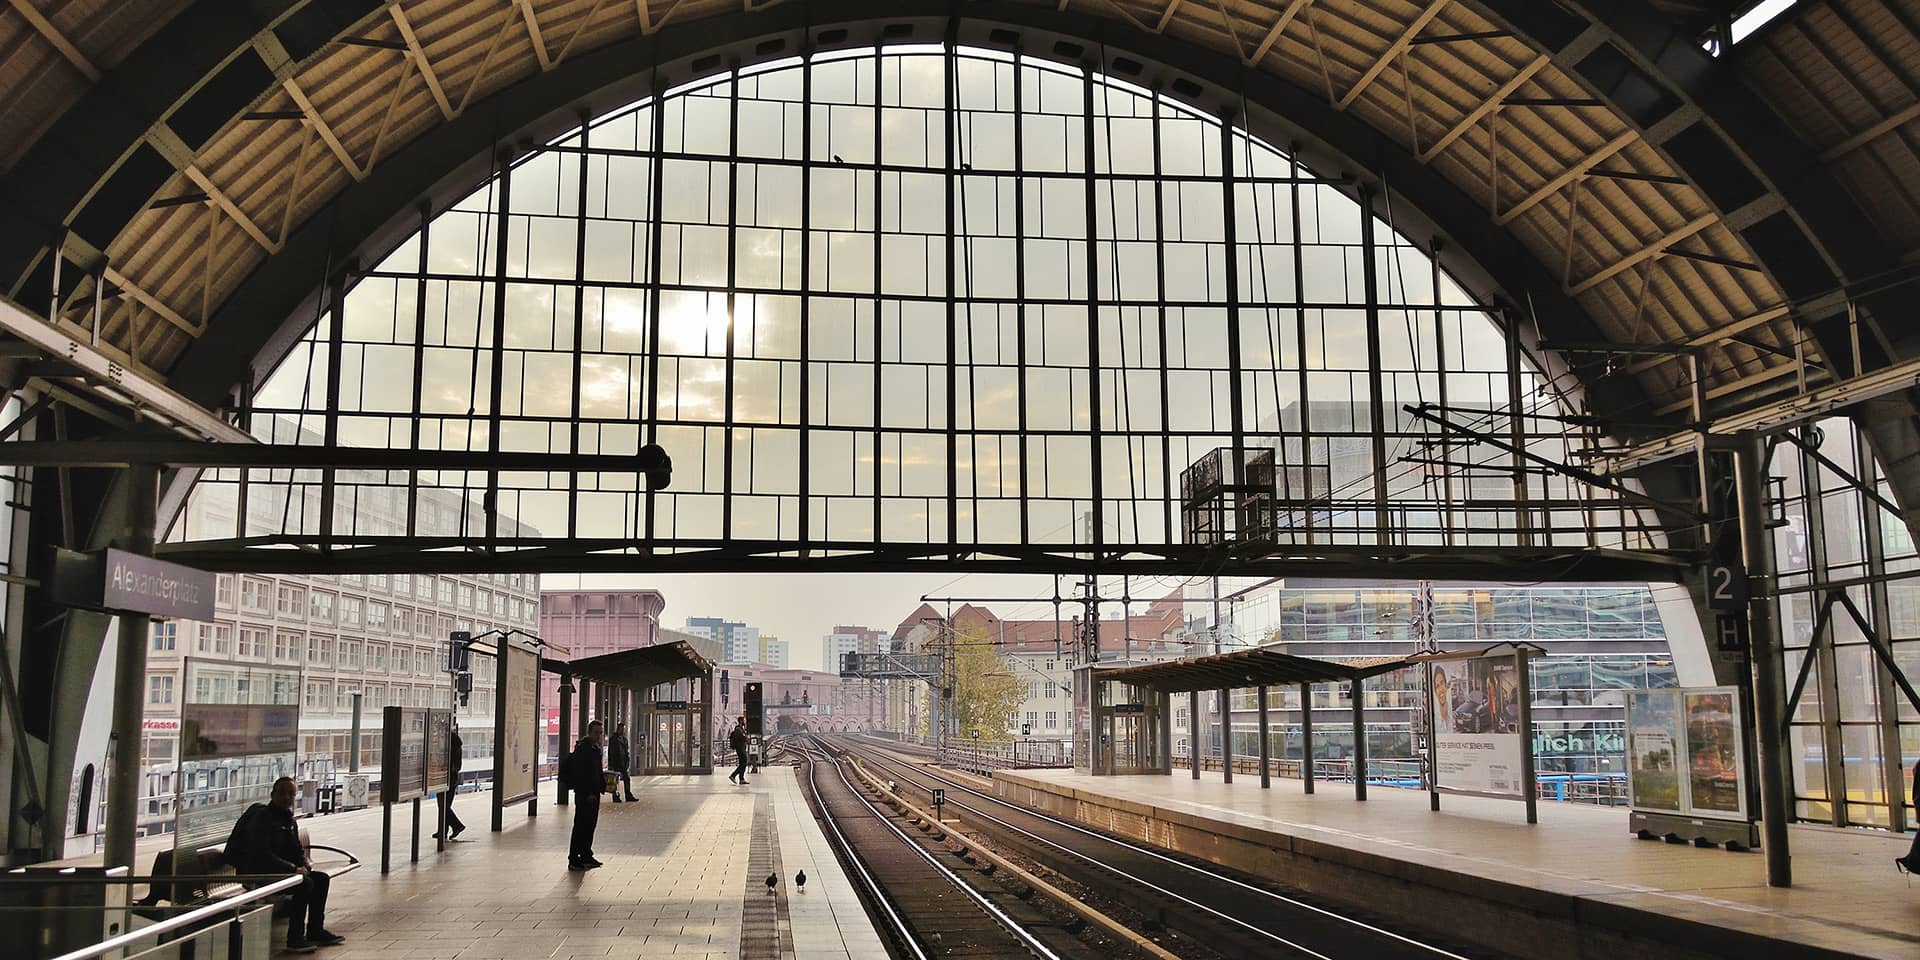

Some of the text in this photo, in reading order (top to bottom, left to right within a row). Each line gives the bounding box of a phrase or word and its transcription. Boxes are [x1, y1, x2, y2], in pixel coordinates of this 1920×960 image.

[111, 561, 201, 607] Alexanderplatz
[1713, 567, 1733, 600] 2
[1721, 619, 1739, 645] H
[1419, 736, 1427, 748] H
[319, 791, 333, 810] H
[934, 790, 943, 804] H
